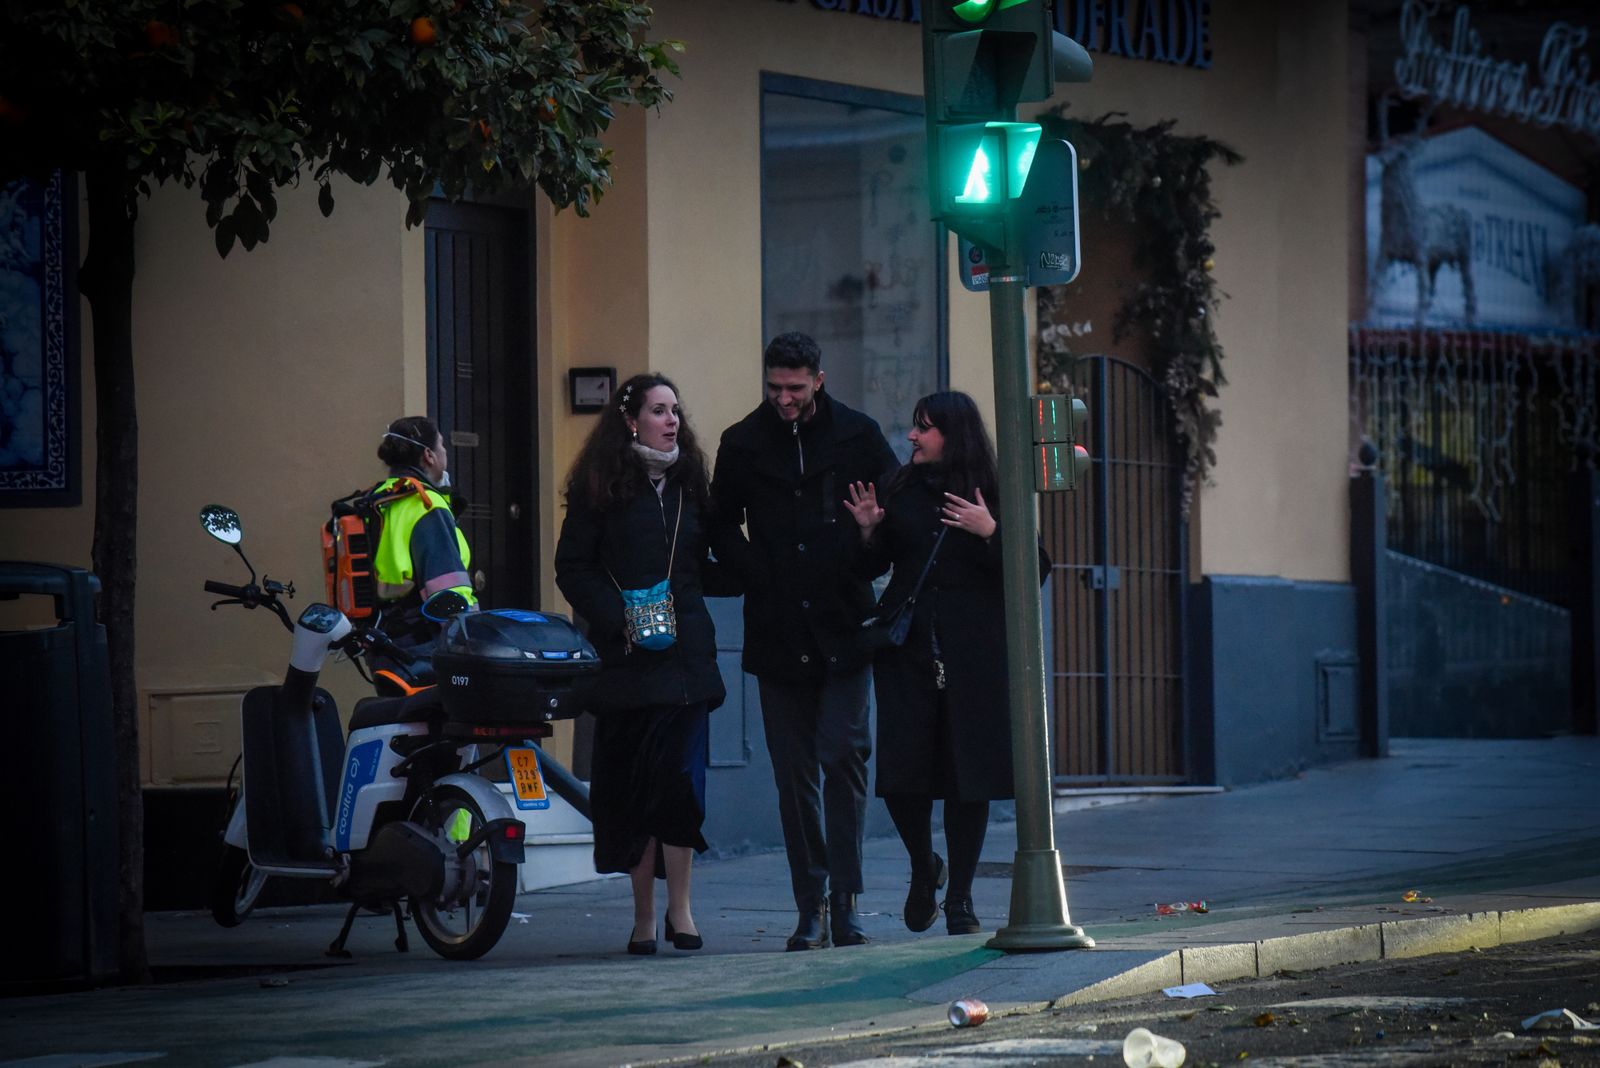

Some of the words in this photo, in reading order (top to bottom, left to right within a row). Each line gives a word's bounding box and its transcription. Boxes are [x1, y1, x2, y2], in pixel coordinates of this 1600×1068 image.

[451, 675, 469, 687] 0197
[517, 756, 529, 767] C7
[339, 783, 354, 835] cooltra
